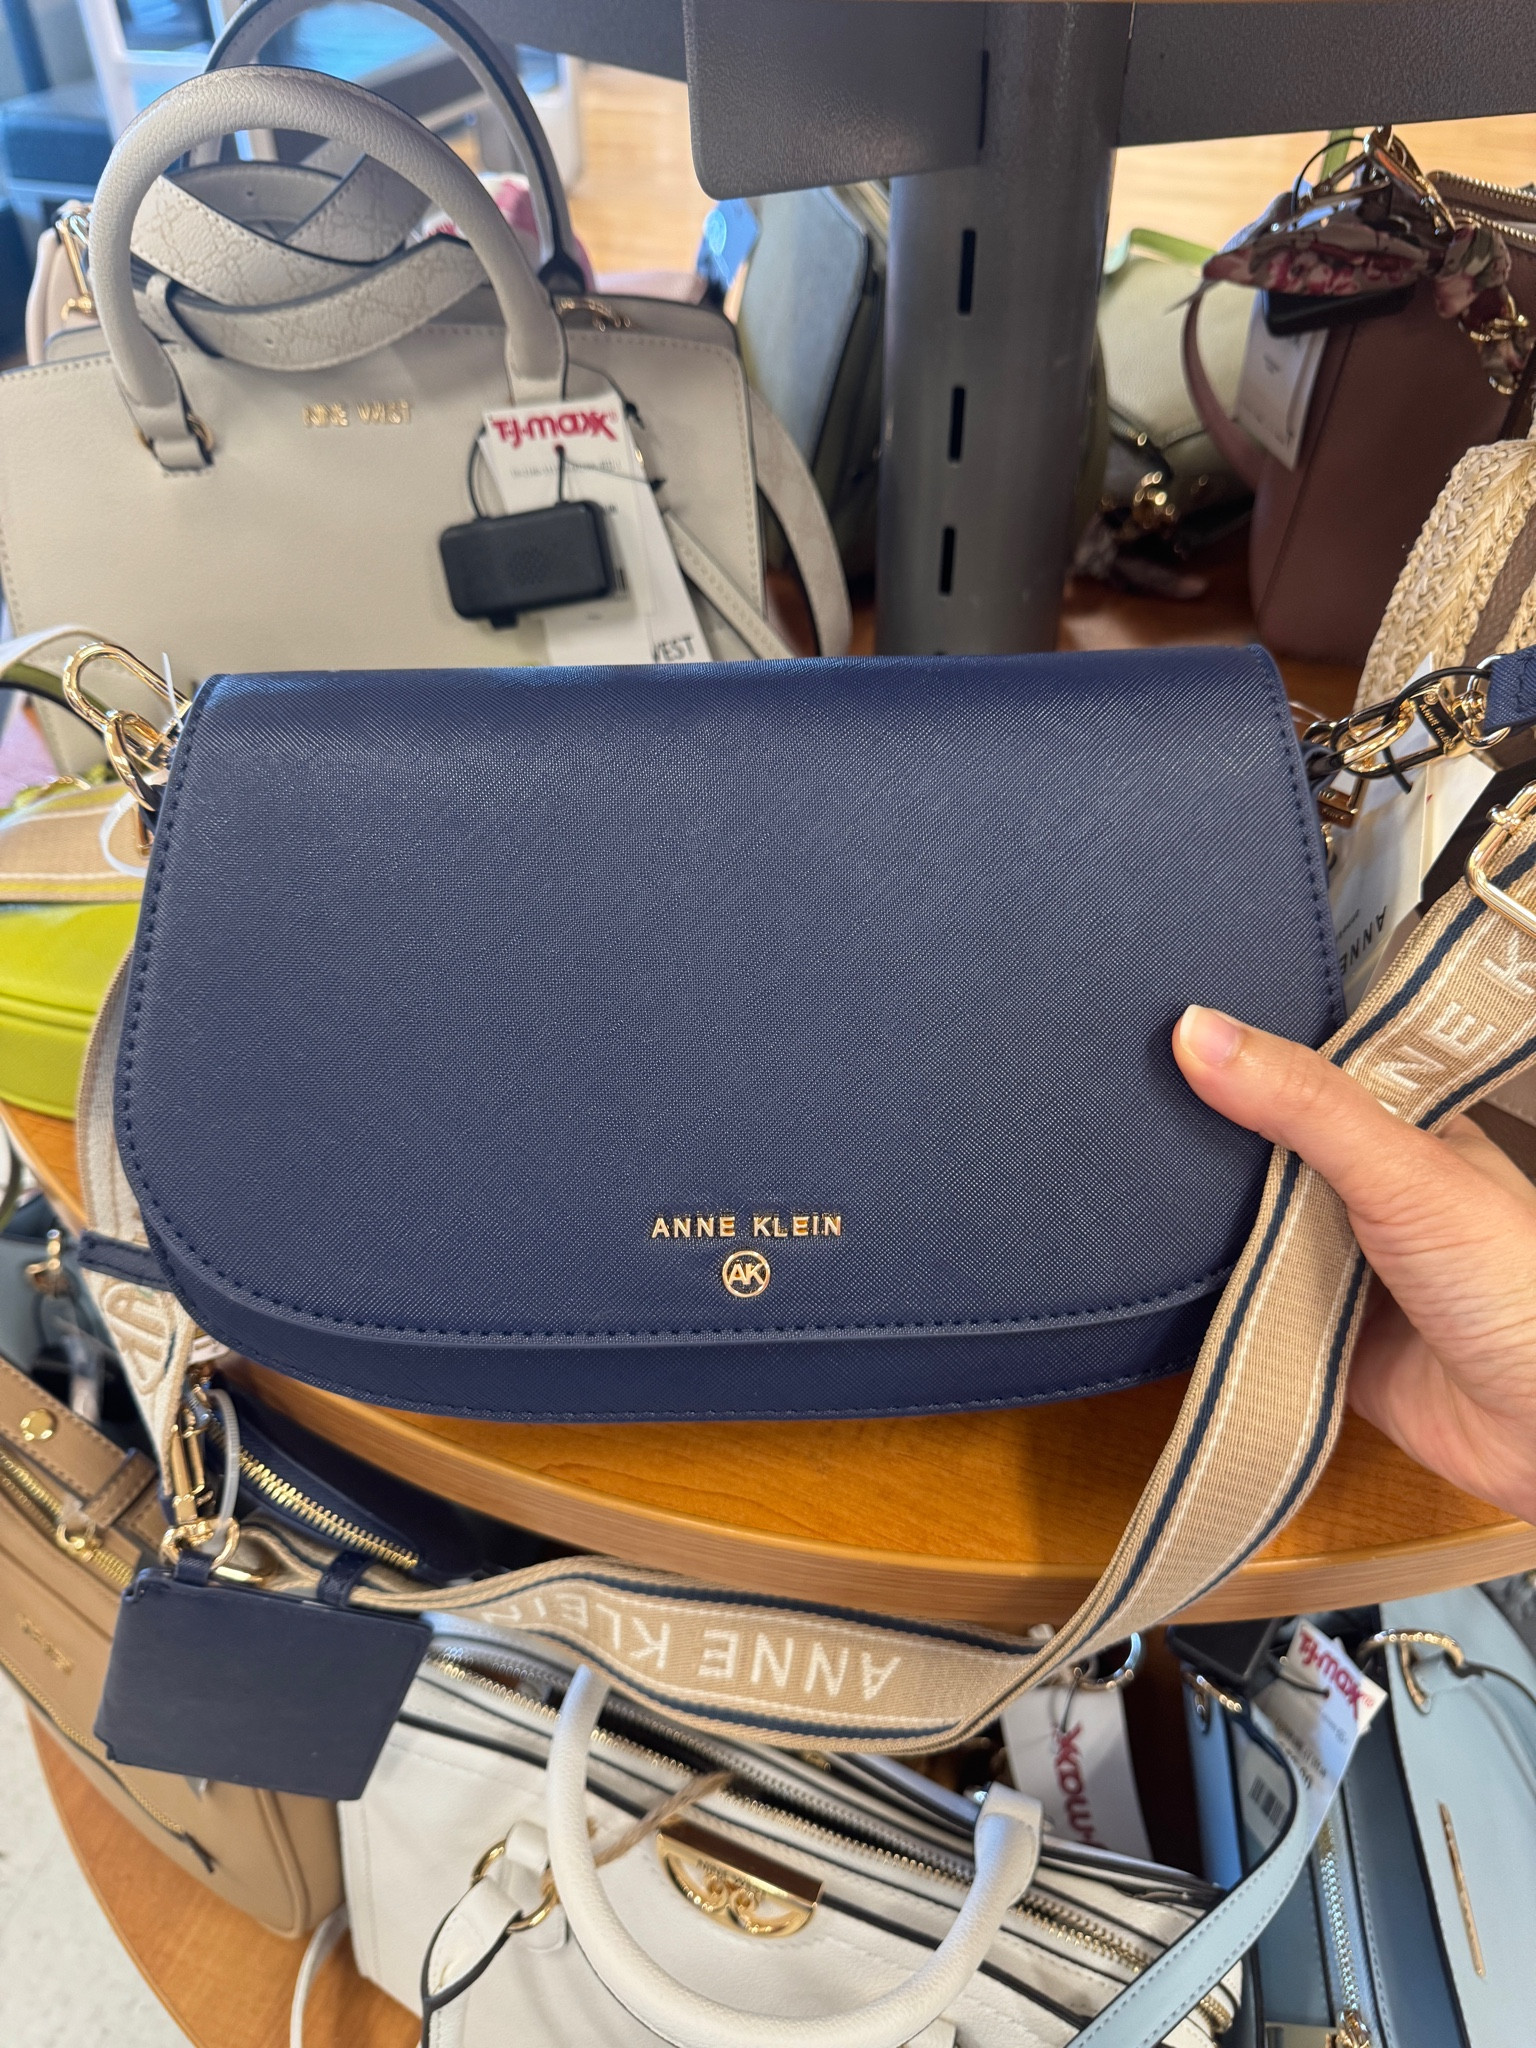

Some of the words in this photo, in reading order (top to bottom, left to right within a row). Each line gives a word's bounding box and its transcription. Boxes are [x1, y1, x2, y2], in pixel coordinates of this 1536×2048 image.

[653, 636, 695, 663] EST
[1372, 1001, 1498, 1116] NE
[650, 1216, 736, 1239] ANNE
[752, 1215, 842, 1238] KLEIN
[698, 1628, 901, 1701] ANNE
